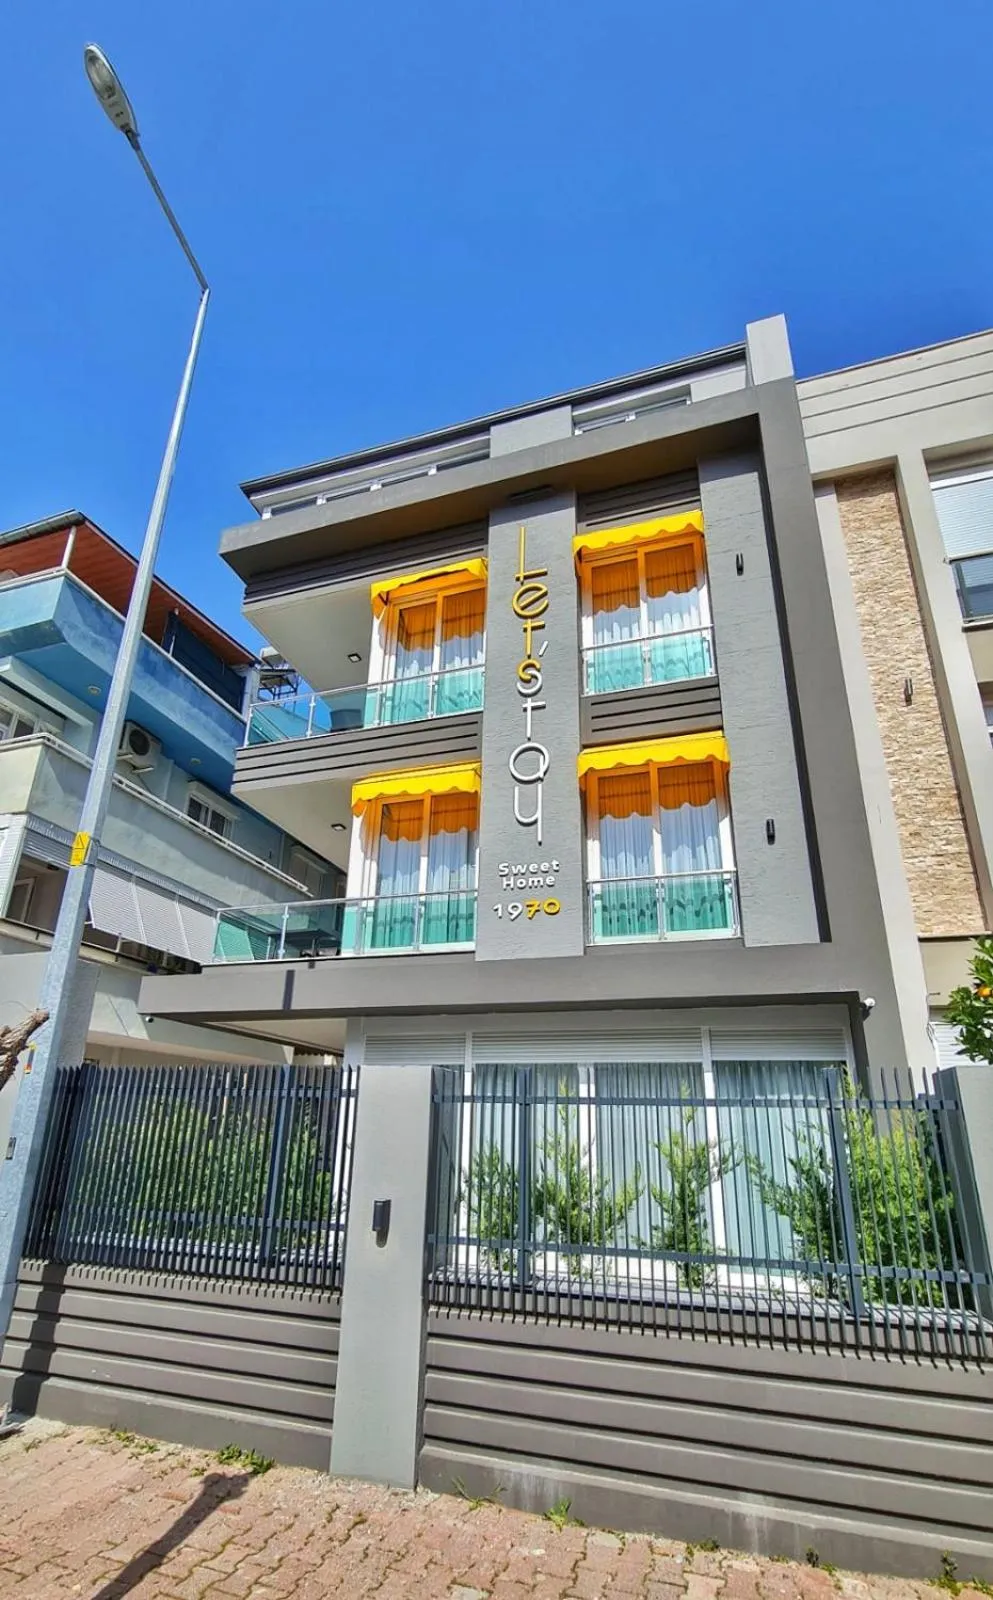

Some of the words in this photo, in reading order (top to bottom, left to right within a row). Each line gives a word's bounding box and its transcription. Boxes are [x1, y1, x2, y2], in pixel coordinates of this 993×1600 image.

[498, 860, 560, 876] Sweet
[502, 876, 556, 890] Home
[493, 899, 561, 920] 1970
